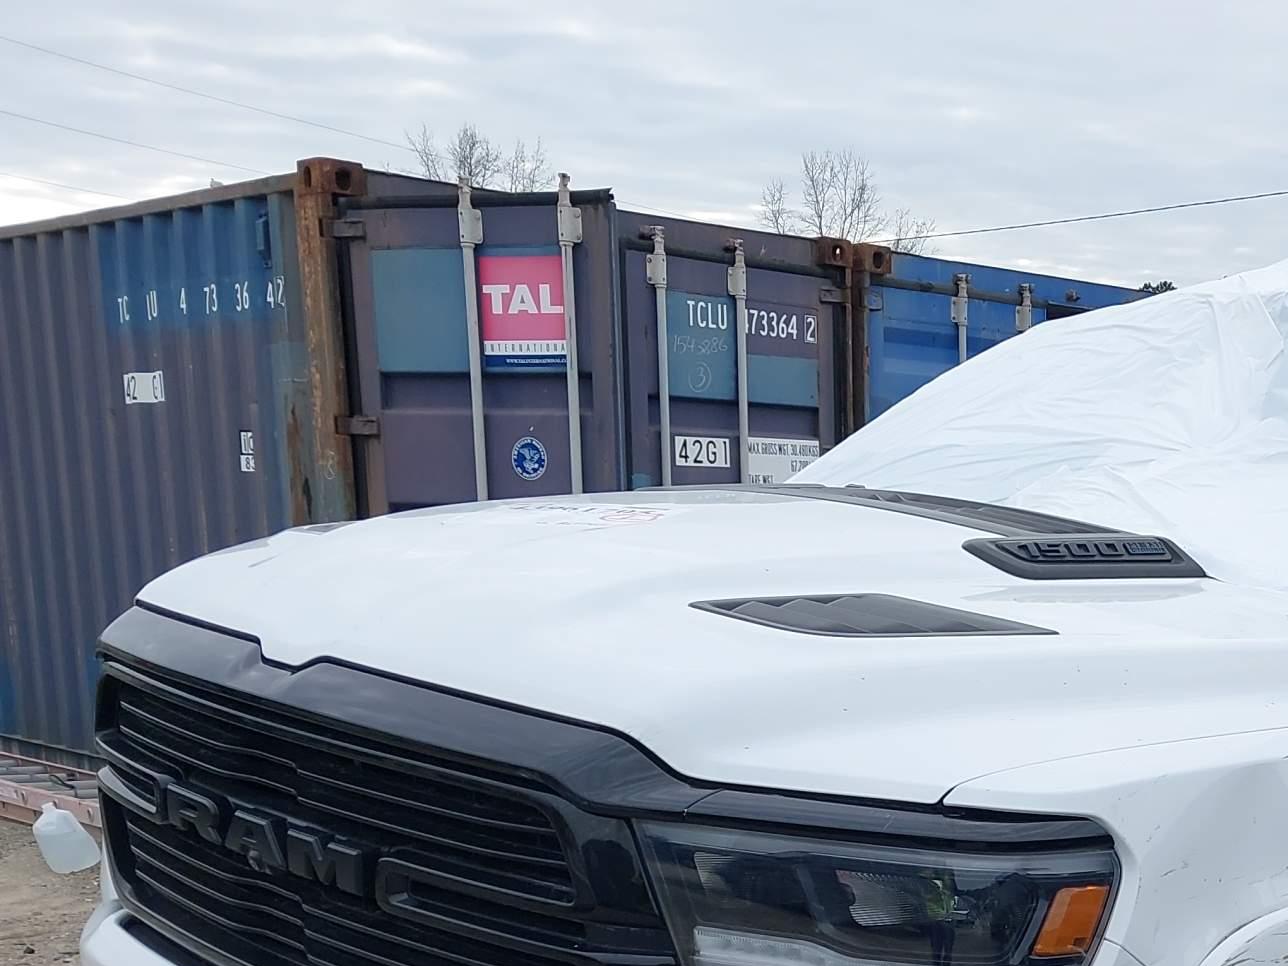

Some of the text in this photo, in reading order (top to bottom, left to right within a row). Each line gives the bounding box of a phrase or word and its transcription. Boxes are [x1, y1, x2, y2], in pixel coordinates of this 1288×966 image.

[483, 284, 564, 314] TAL
[687, 300, 727, 329] TCLU
[745, 308, 797, 340] 73364
[485, 343, 565, 353] INTERNATIONA
[679, 438, 728, 465] 42G1
[1017, 541, 1125, 559] 1500
[167, 783, 364, 898] RAM
